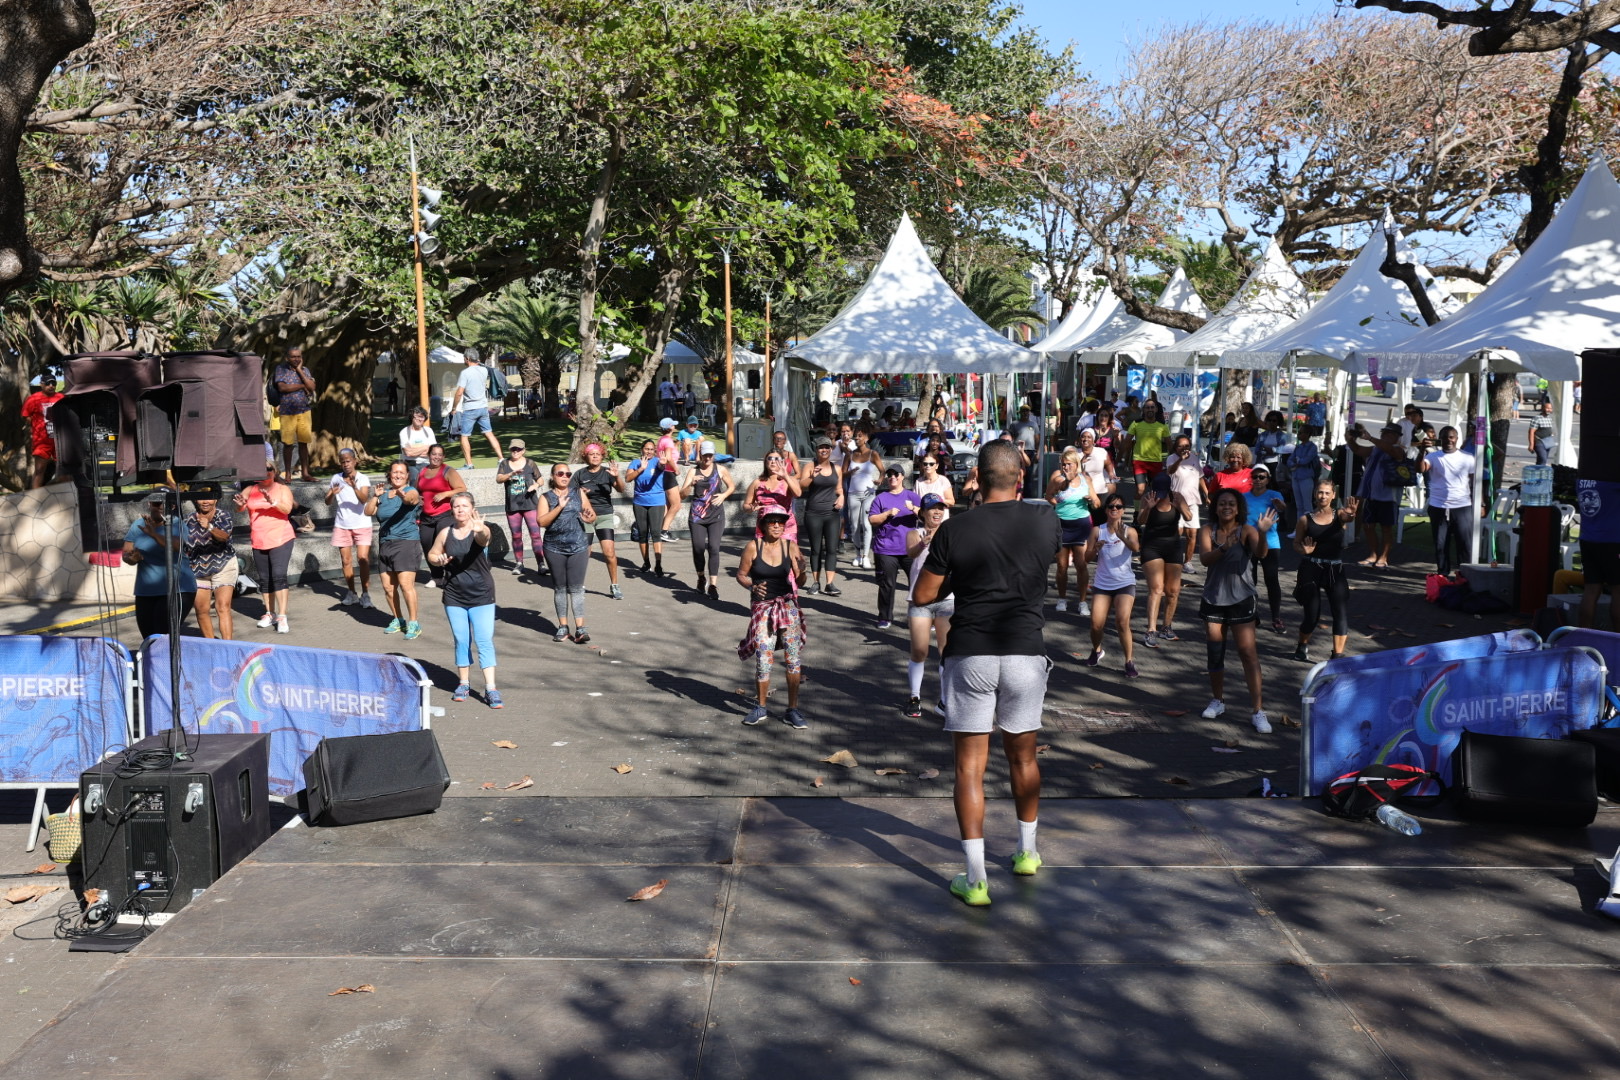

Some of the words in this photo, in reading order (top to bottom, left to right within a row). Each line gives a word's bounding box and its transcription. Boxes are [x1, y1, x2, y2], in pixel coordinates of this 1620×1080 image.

[0, 677, 84, 697] PIERRE
[262, 684, 385, 717] SAINT-PIERRE
[1444, 691, 1566, 724] SAINT-PIERRE
